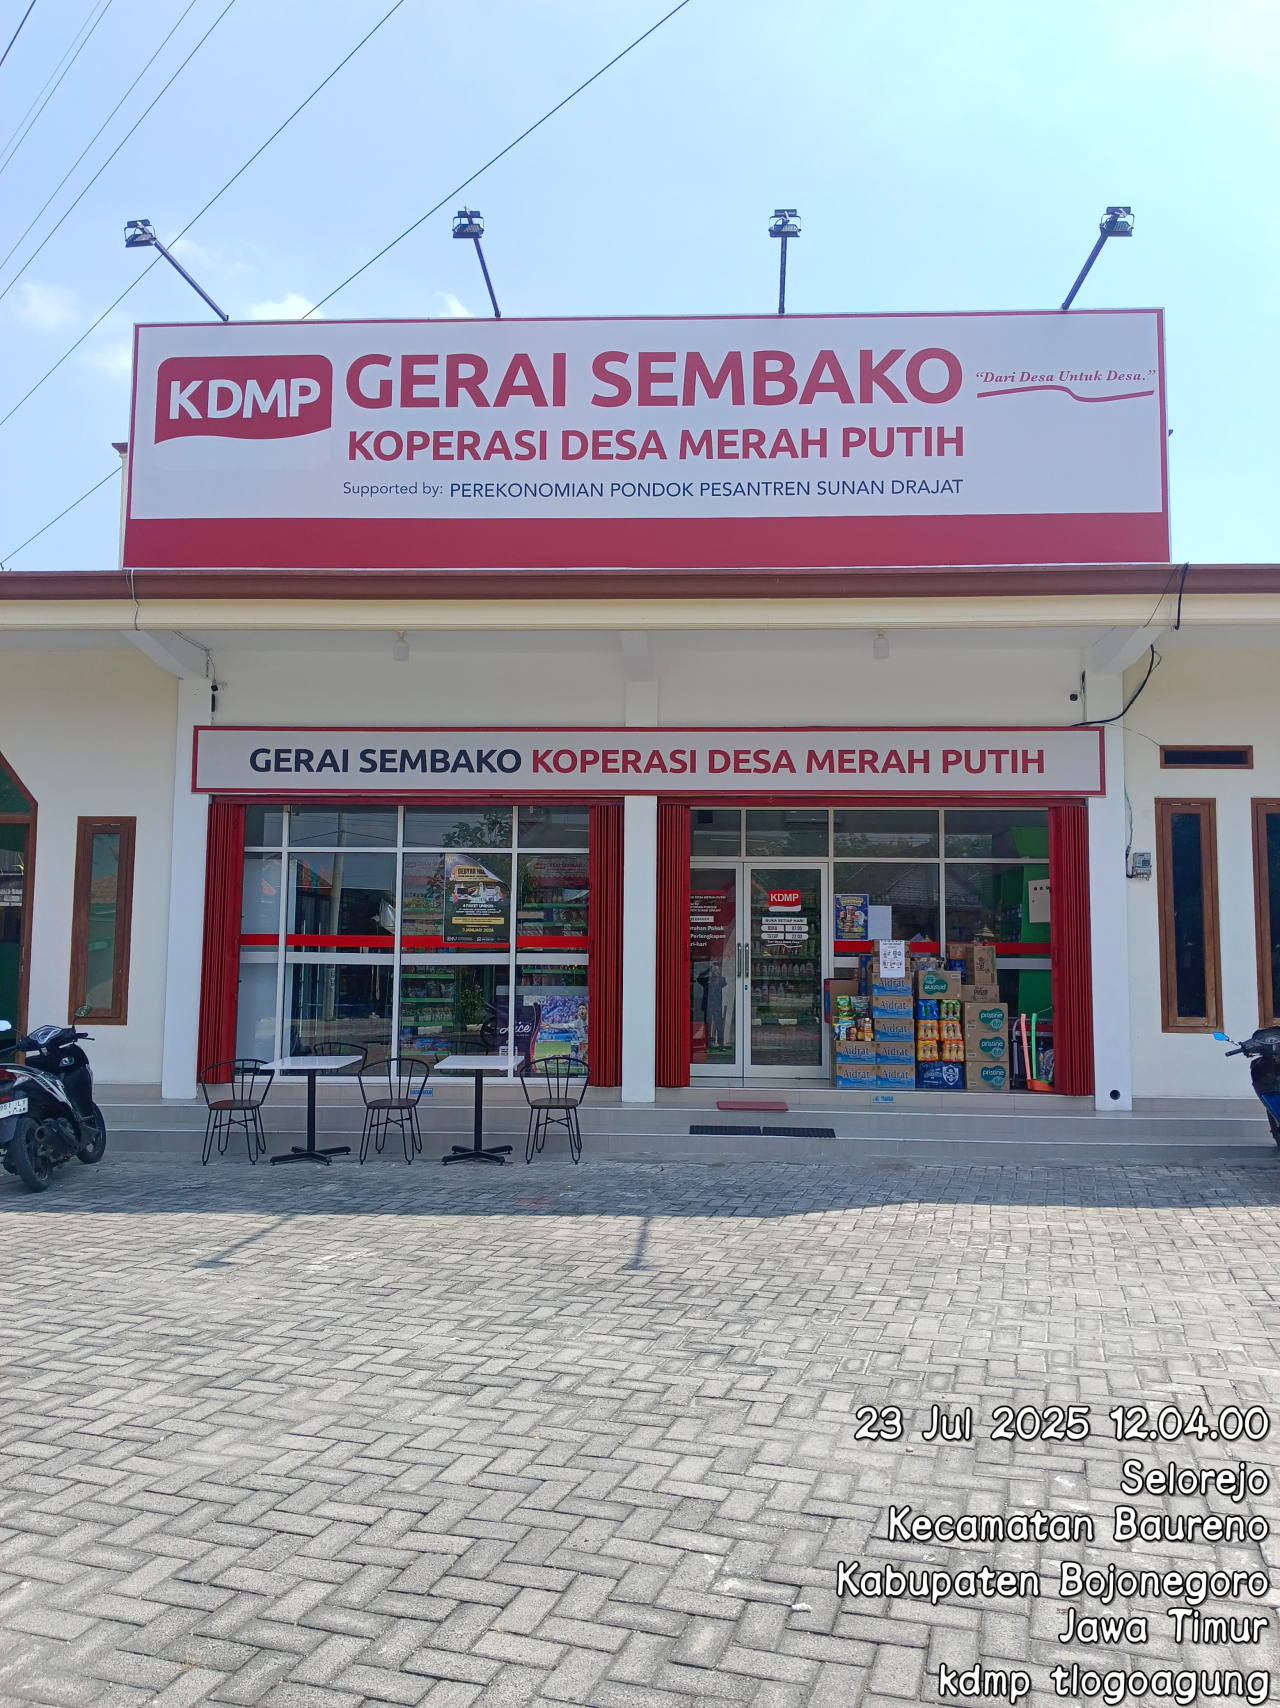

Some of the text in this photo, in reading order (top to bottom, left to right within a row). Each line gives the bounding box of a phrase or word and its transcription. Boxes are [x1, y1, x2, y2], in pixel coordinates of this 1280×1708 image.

[346, 348, 962, 409] GERAI SEMBAKO
[1019, 371, 1054, 382] Desa
[1058, 370, 1102, 382] Untuk
[169, 377, 321, 420] KDMP
[349, 426, 963, 461] KOPERASI DESA MERAH PUTIH
[343, 478, 964, 498] Supported by: PEREKONOMIAN PONDOK PESANTREN SUNAN DRAJAT
[249, 747, 1045, 774] GERAI SEMBAKO KOPERASI DESA MERAH PUTIH
[770, 893, 799, 902] KDMP
[878, 977, 905, 988] Aidrat
[880, 999, 907, 1011] Aidrat
[881, 1023, 908, 1034] Aidrat
[981, 1040, 1004, 1048] pristine
[842, 1045, 870, 1056] Aidrat
[881, 1046, 908, 1057] Aidrat
[843, 1068, 870, 1080] Aidrat
[882, 1068, 909, 1080] Aidrat
[982, 1069, 1005, 1077] pristine
